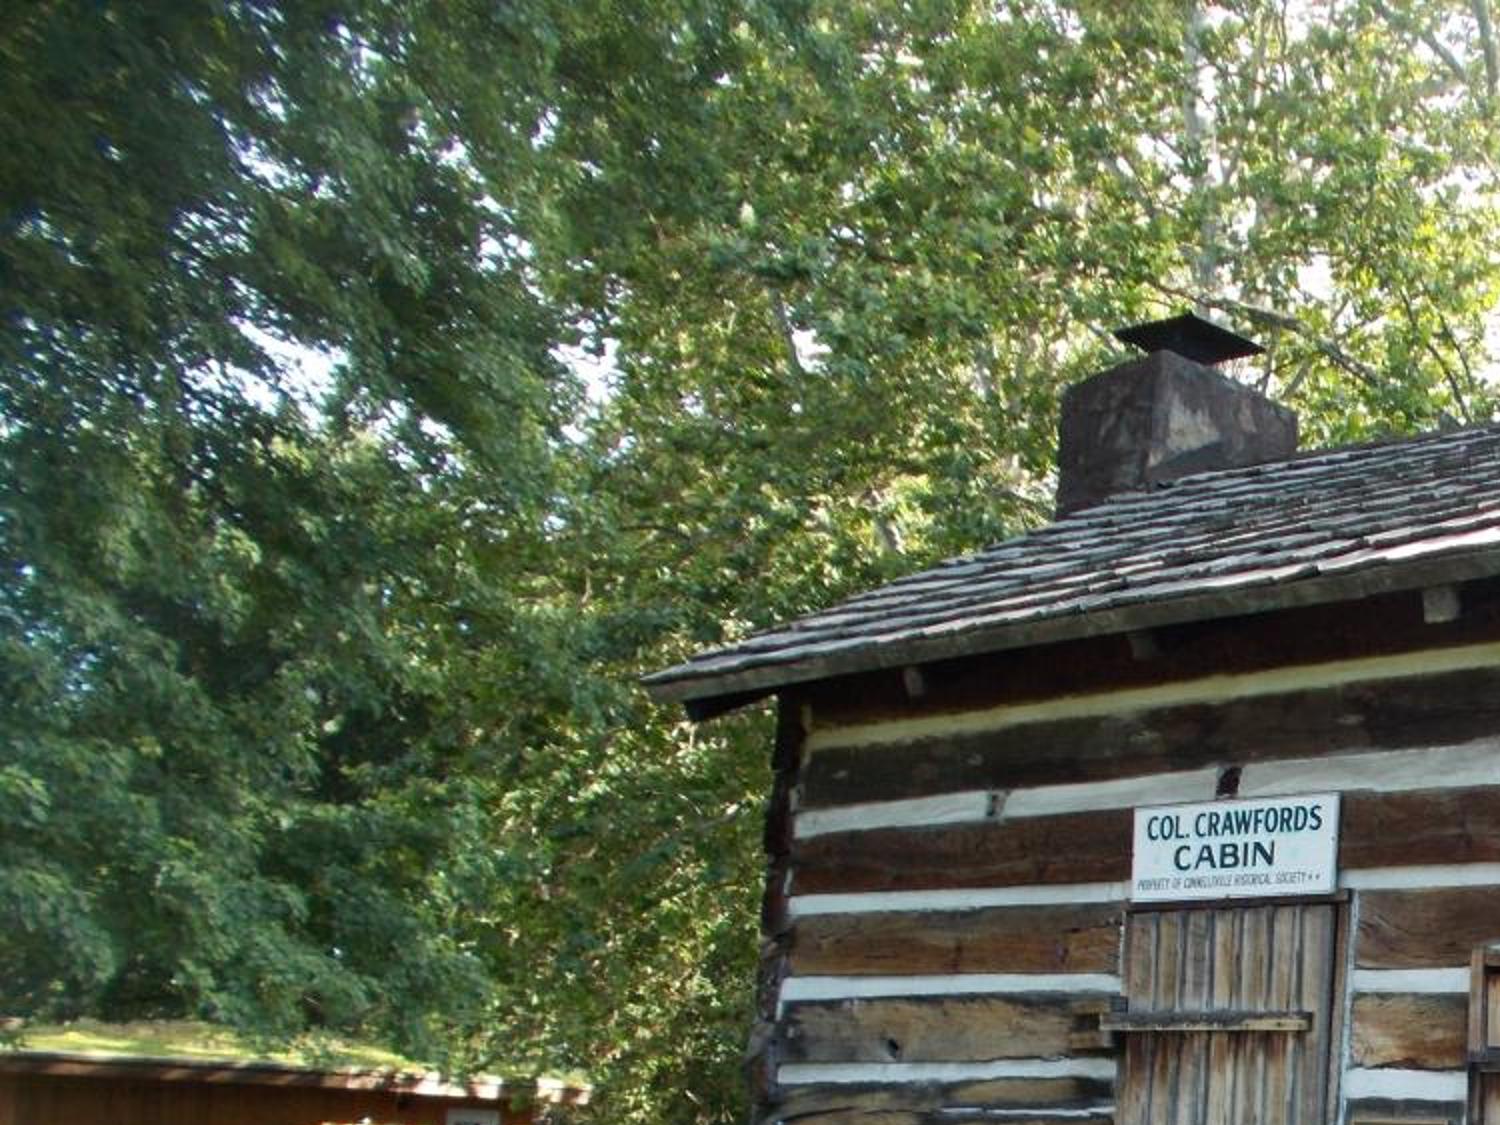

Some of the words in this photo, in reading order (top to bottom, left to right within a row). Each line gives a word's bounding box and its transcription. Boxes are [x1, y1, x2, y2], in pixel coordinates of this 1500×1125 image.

[1147, 815, 1191, 841] COL.
[1194, 805, 1323, 839] CRAWFORDS
[1173, 840, 1276, 872] CABIN
